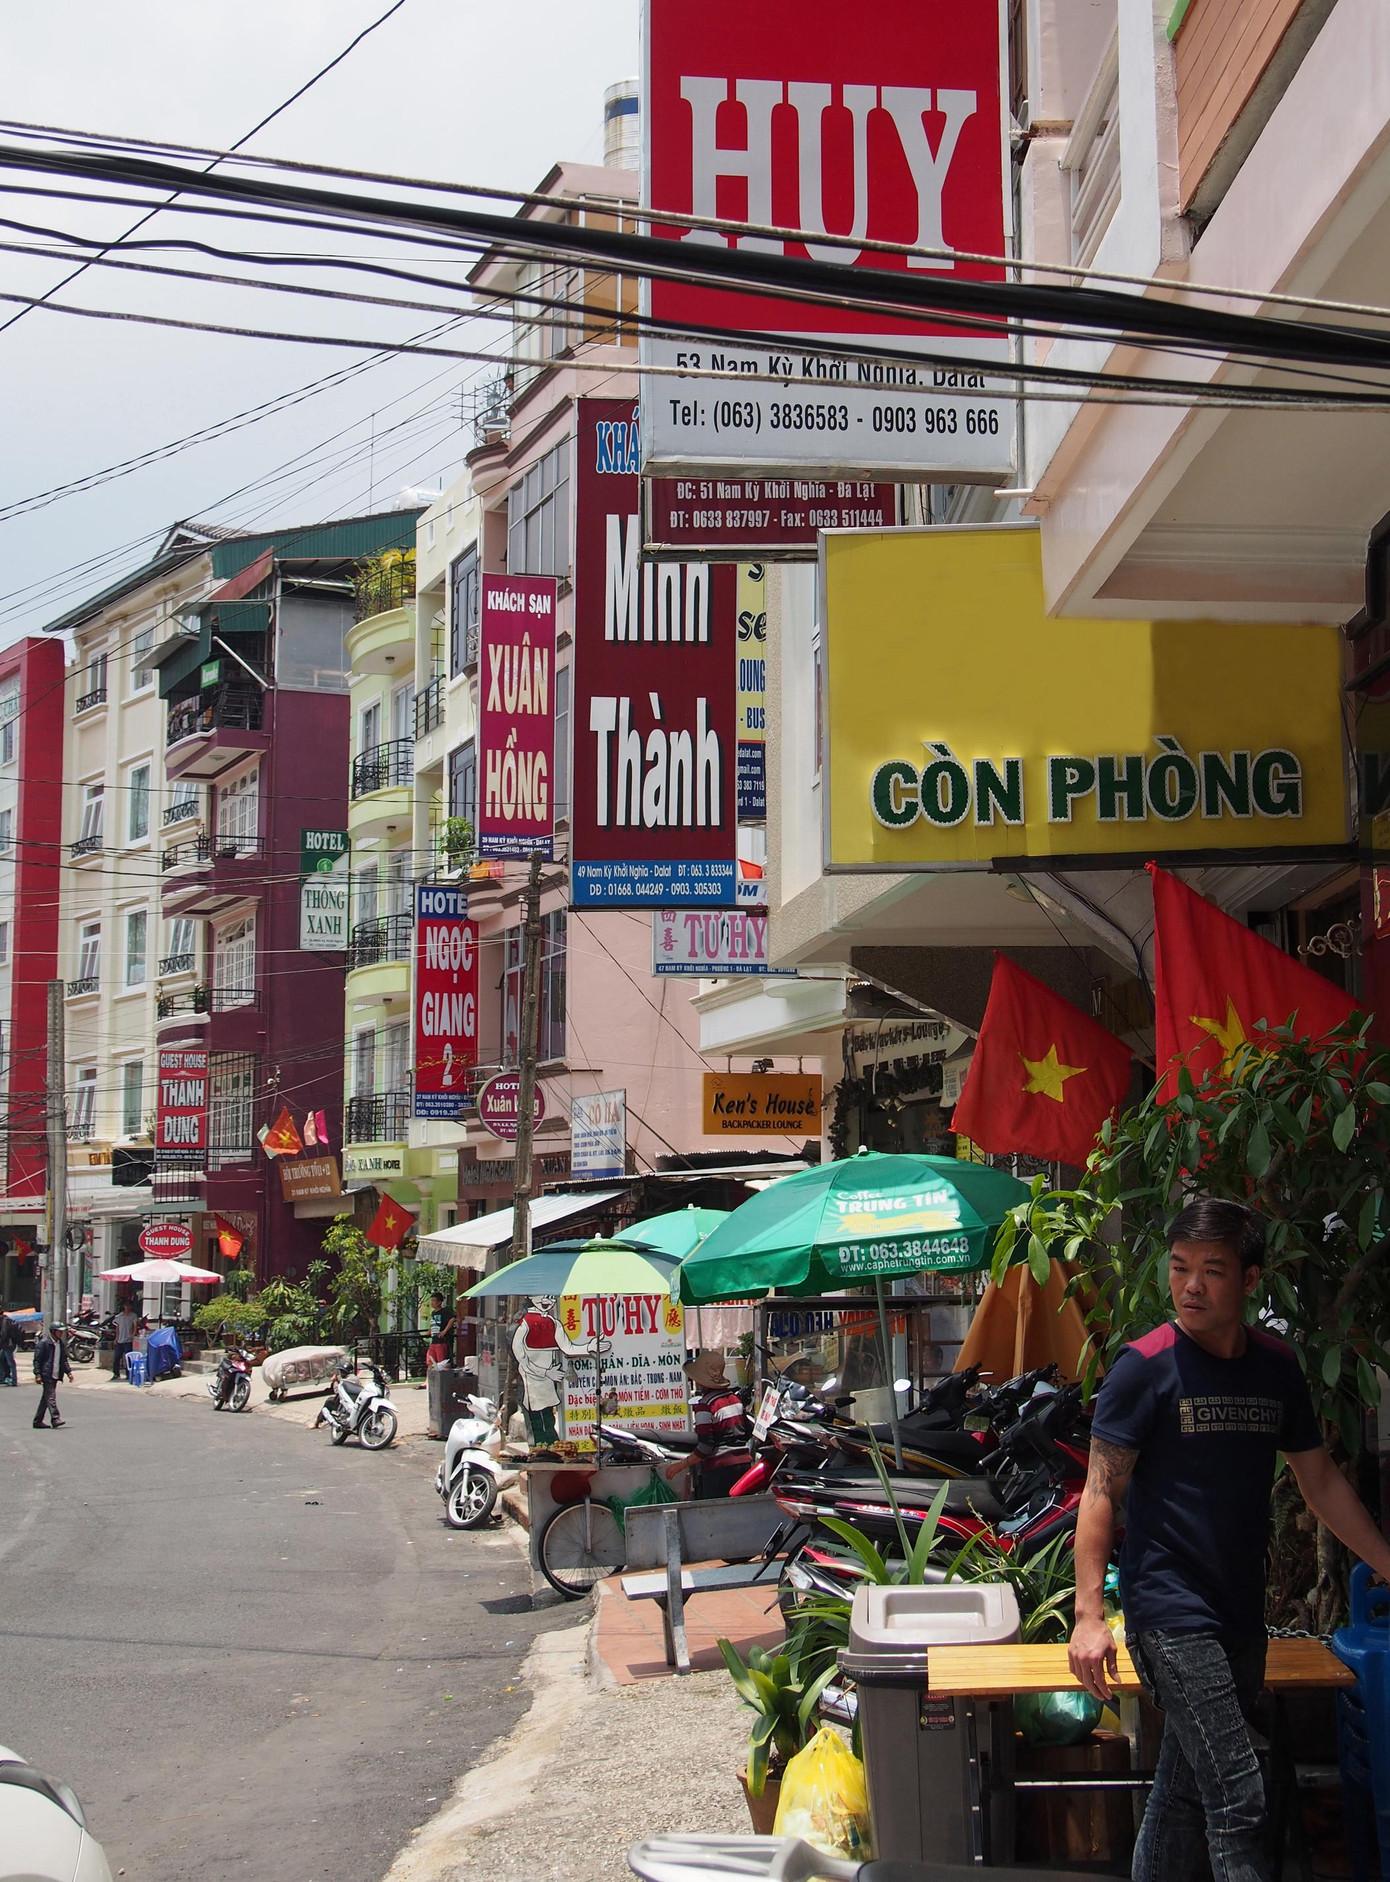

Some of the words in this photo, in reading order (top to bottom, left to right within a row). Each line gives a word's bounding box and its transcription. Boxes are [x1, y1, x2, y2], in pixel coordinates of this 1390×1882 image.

[680, 76, 977, 270] HUY
[676, 353, 701, 379] 53
[711, 354, 758, 380] Nam
[768, 355, 793, 388] Kỳ
[670, 399, 705, 427] Tel:
[714, 400, 761, 435] (063)
[770, 403, 849, 431] 3836583
[872, 406, 916, 433] 0903
[925, 408, 957, 434] 963
[966, 408, 999, 435] 666
[677, 482, 696, 499] ĐC:
[700, 482, 713, 499] 51
[716, 482, 741, 499] Nam
[745, 482, 759, 502] Kỳ
[794, 481, 826, 501] Nghĩa
[856, 482, 875, 502] Lạt
[670, 511, 689, 528] ĐT:
[692, 511, 722, 528] 0633
[726, 510, 770, 528] 837997
[781, 510, 805, 527] Fax:
[809, 510, 838, 527] 0633
[842, 509, 883, 527] 511444
[487, 588, 525, 613] KHÁCH
[529, 594, 551, 619] SẠN
[487, 632, 549, 716] XUÂN
[746, 707, 766, 730] BUS
[590, 692, 723, 829] Thành
[485, 727, 548, 822] HỒNG
[869, 740, 1025, 829] CÒN
[1047, 734, 1303, 825] PHÒNG
[305, 831, 345, 850] HOTEL
[578, 865, 586, 878] 49
[587, 865, 602, 878] Nam
[603, 865, 612, 880] Kỳ
[614, 862, 628, 877] Khởi
[629, 865, 648, 880] Nghĩa
[654, 865, 671, 877] Dalat
[678, 864, 687, 877] ĐT
[691, 864, 704, 877] 063.
[711, 864, 733, 877] 833344
[304, 884, 345, 909] THÔNG
[590, 884, 602, 895] DĐ
[608, 883, 634, 896] 01668.
[635, 883, 664, 896] 044249
[671, 883, 692, 896] 0903.
[694, 882, 722, 895] 305303
[307, 915, 342, 935] XANH
[426, 926, 473, 984] NGỌC
[422, 991, 475, 1037] GIANG
[161, 1053, 183, 1068] GUEST
[184, 1054, 206, 1068] HOUSE
[162, 1079, 204, 1107] THANH
[487, 1094, 512, 1113] Xuân
[713, 1092, 758, 1115] Ken's
[765, 1092, 815, 1116] House
[164, 1116, 199, 1144] DUNG
[722, 1120, 772, 1130] BACKPACKER
[772, 1120, 803, 1130] LOUNGE
[383, 1160, 401, 1170] HOTEL
[836, 1190, 884, 1201] Coffee
[836, 1197, 907, 1214] TRUNG
[145, 1225, 168, 1237] GUEST
[168, 1225, 191, 1237] HOUSE
[145, 1237, 169, 1246] THANH
[170, 1237, 191, 1246] DUNG
[838, 1245, 866, 1264] ĐT:
[870, 1237, 970, 1261] 063.3844648
[840, 1253, 971, 1273] www.caphetrungtin.com.vn
[631, 1354, 651, 1368] DĨA
[658, 1352, 681, 1366] MÓN
[647, 1372, 664, 1384] TRUNG
[669, 1371, 682, 1383] NAM
[568, 1394, 583, 1407] Đặc
[618, 1388, 633, 1402] MÓN
[1197, 1407, 1277, 1422] GIVENCHY
